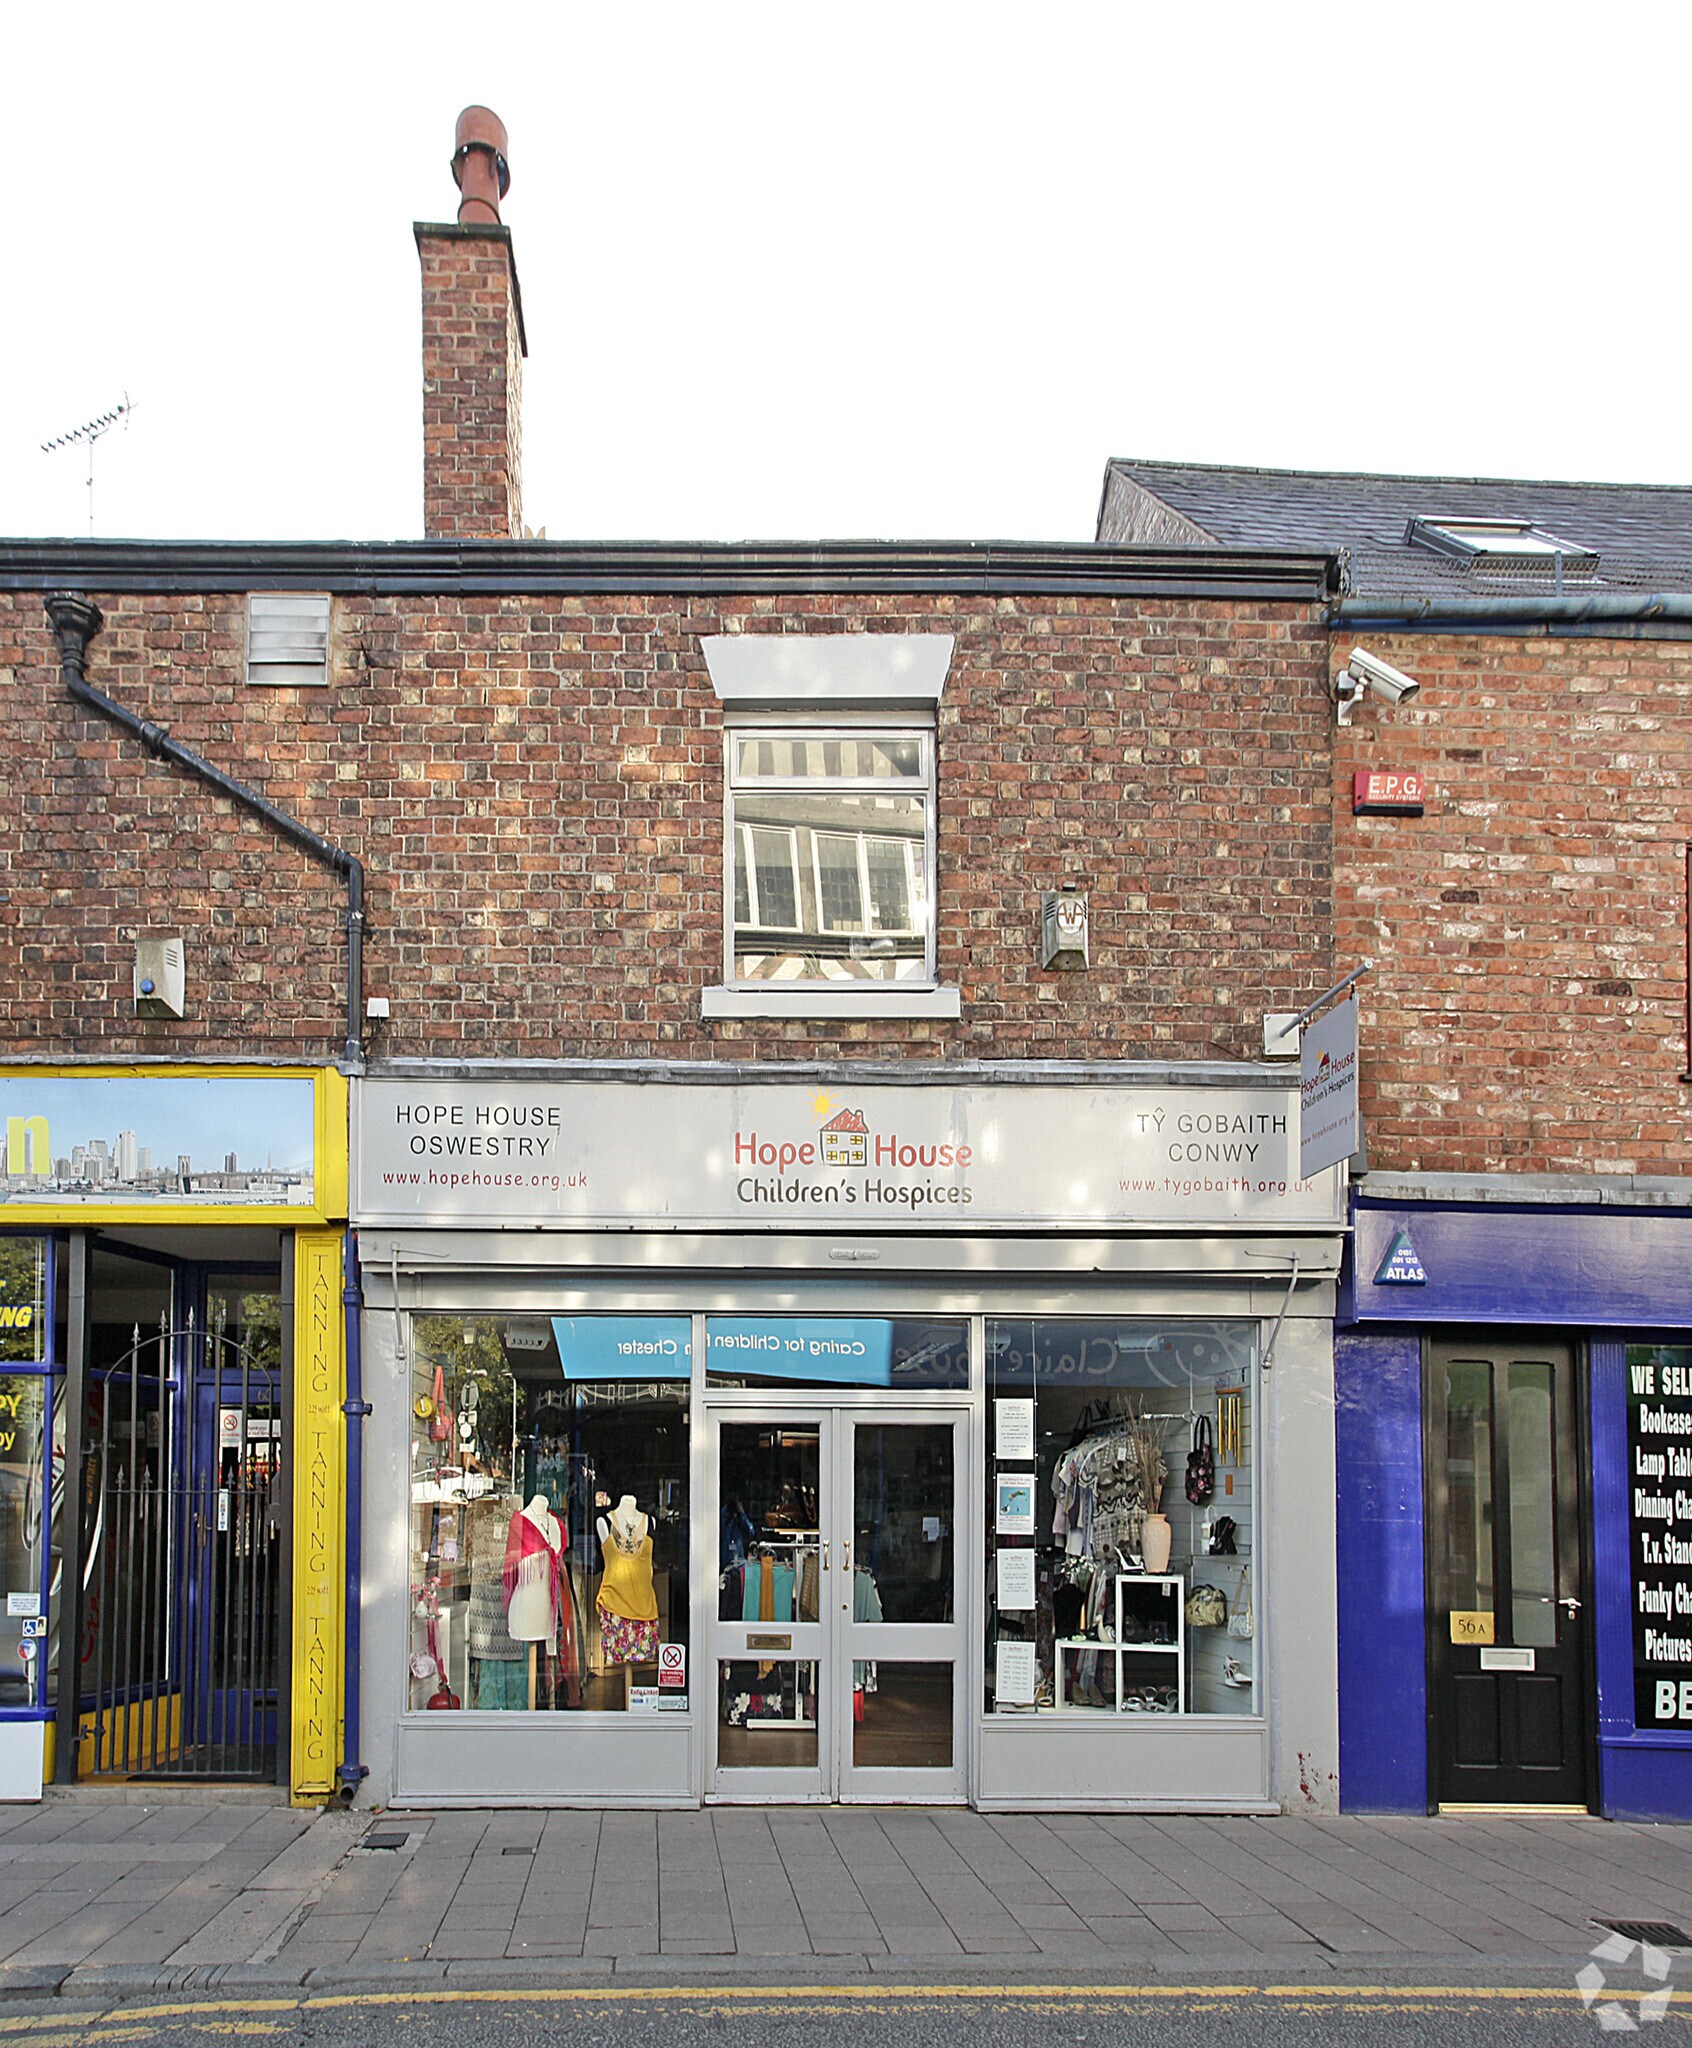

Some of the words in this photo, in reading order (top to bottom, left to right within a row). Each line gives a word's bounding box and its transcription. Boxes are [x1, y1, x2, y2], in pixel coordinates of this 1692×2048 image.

[1301, 1075, 1319, 1095] Hope
[1331, 1052, 1355, 1076] House
[1301, 1086, 1328, 1111] Children's
[1328, 1072, 1354, 1094] Hospices
[396, 1105, 464, 1126] HOPE
[475, 1106, 561, 1127] HOUSE
[1177, 1114, 1287, 1134] GOBAITH
[410, 1135, 551, 1157] OSWESTRY
[734, 1132, 815, 1175] Hope
[875, 1134, 973, 1168] House
[1168, 1143, 1260, 1162] CONWY
[382, 1169, 588, 1191] www.hopehouse.org.uk
[736, 1177, 858, 1203] Children's
[865, 1179, 973, 1211] Hospices
[1119, 1176, 1314, 1197] www.tygobaith.org.uk
[1386, 1267, 1424, 1280] ATLAS
[0, 1306, 32, 1328] NG
[312, 1254, 329, 1393] TANNING
[1631, 1365, 1655, 1394] WE
[1640, 1403, 1692, 1434] Bookcase
[1636, 1445, 1665, 1483] Lamp
[309, 1431, 327, 1573] TANNING
[1634, 1488, 1673, 1526] Dinning
[1642, 1532, 1662, 1564] T.v.
[1638, 1581, 1673, 1621] Funky
[1645, 1628, 1692, 1662] Pictures
[307, 1617, 326, 1760] TANNING
